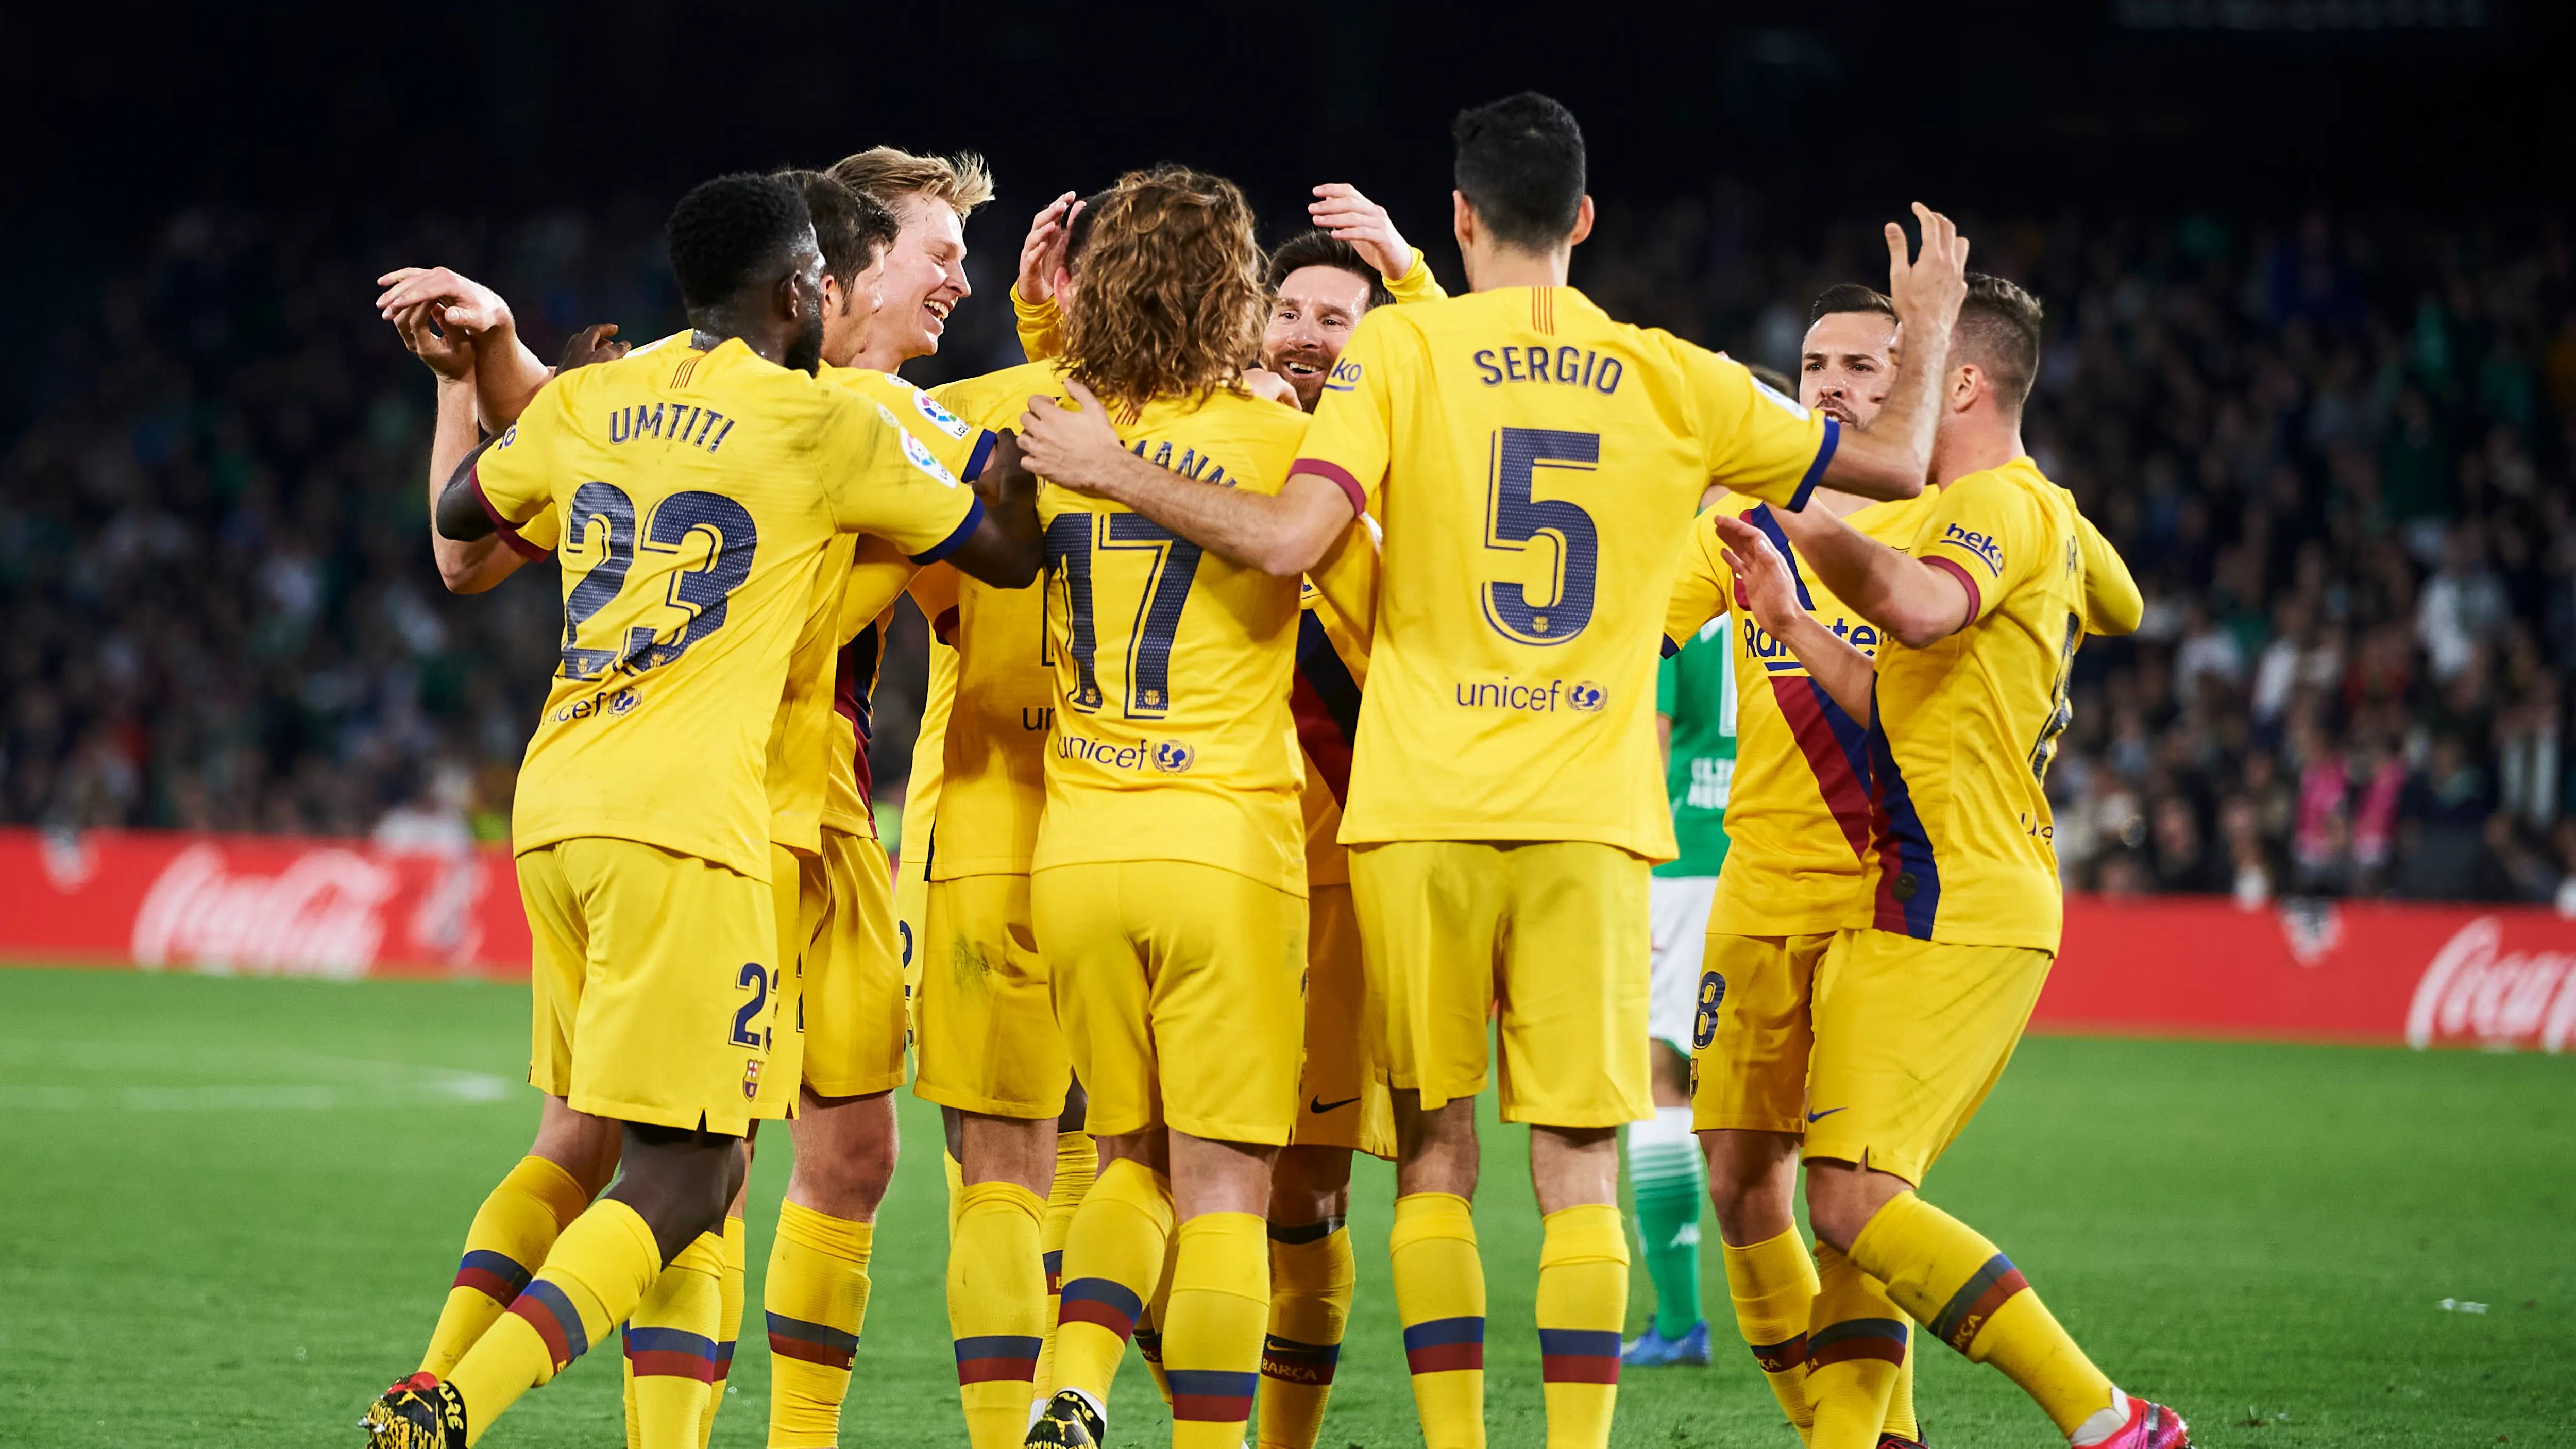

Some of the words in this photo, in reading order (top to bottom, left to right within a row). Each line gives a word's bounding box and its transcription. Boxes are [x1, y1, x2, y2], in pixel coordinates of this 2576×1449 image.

[1473, 346, 1623, 396] SERGIO
[609, 402, 736, 454] UMTITI
[1481, 427, 1600, 646] 5
[561, 481, 757, 681] 23
[1044, 512, 1204, 720] 17
[1456, 676, 1562, 712] unicef
[1058, 737, 1147, 771] unicef
